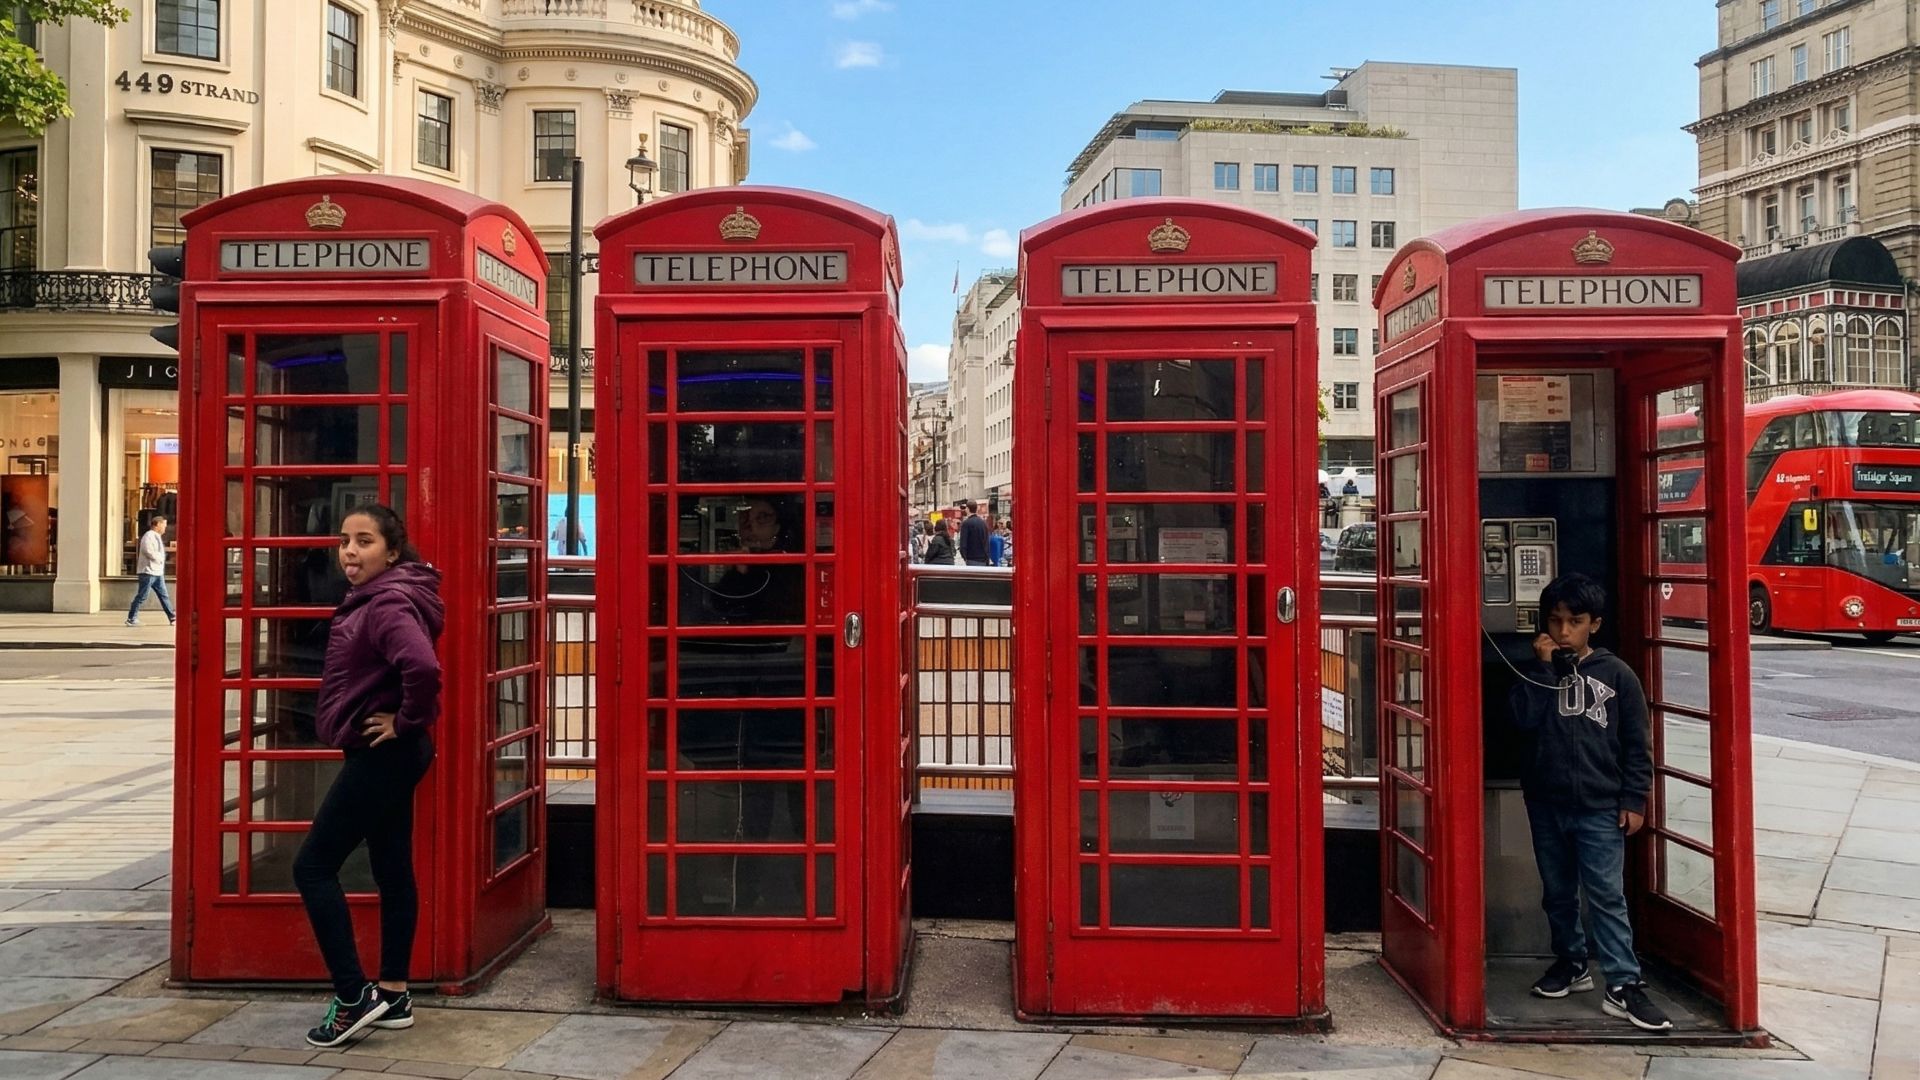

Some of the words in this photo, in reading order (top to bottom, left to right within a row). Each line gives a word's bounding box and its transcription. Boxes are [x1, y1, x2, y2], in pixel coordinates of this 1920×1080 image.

[115, 70, 174, 94] 449
[180, 80, 260, 105] STRAND
[229, 242, 422, 268] TELEPHONE
[642, 255, 839, 281] TELEPHONE
[478, 251, 535, 305] TELEPHONE
[1069, 266, 1269, 294] TELEPHONE
[1492, 278, 1692, 305] TELEPHONE
